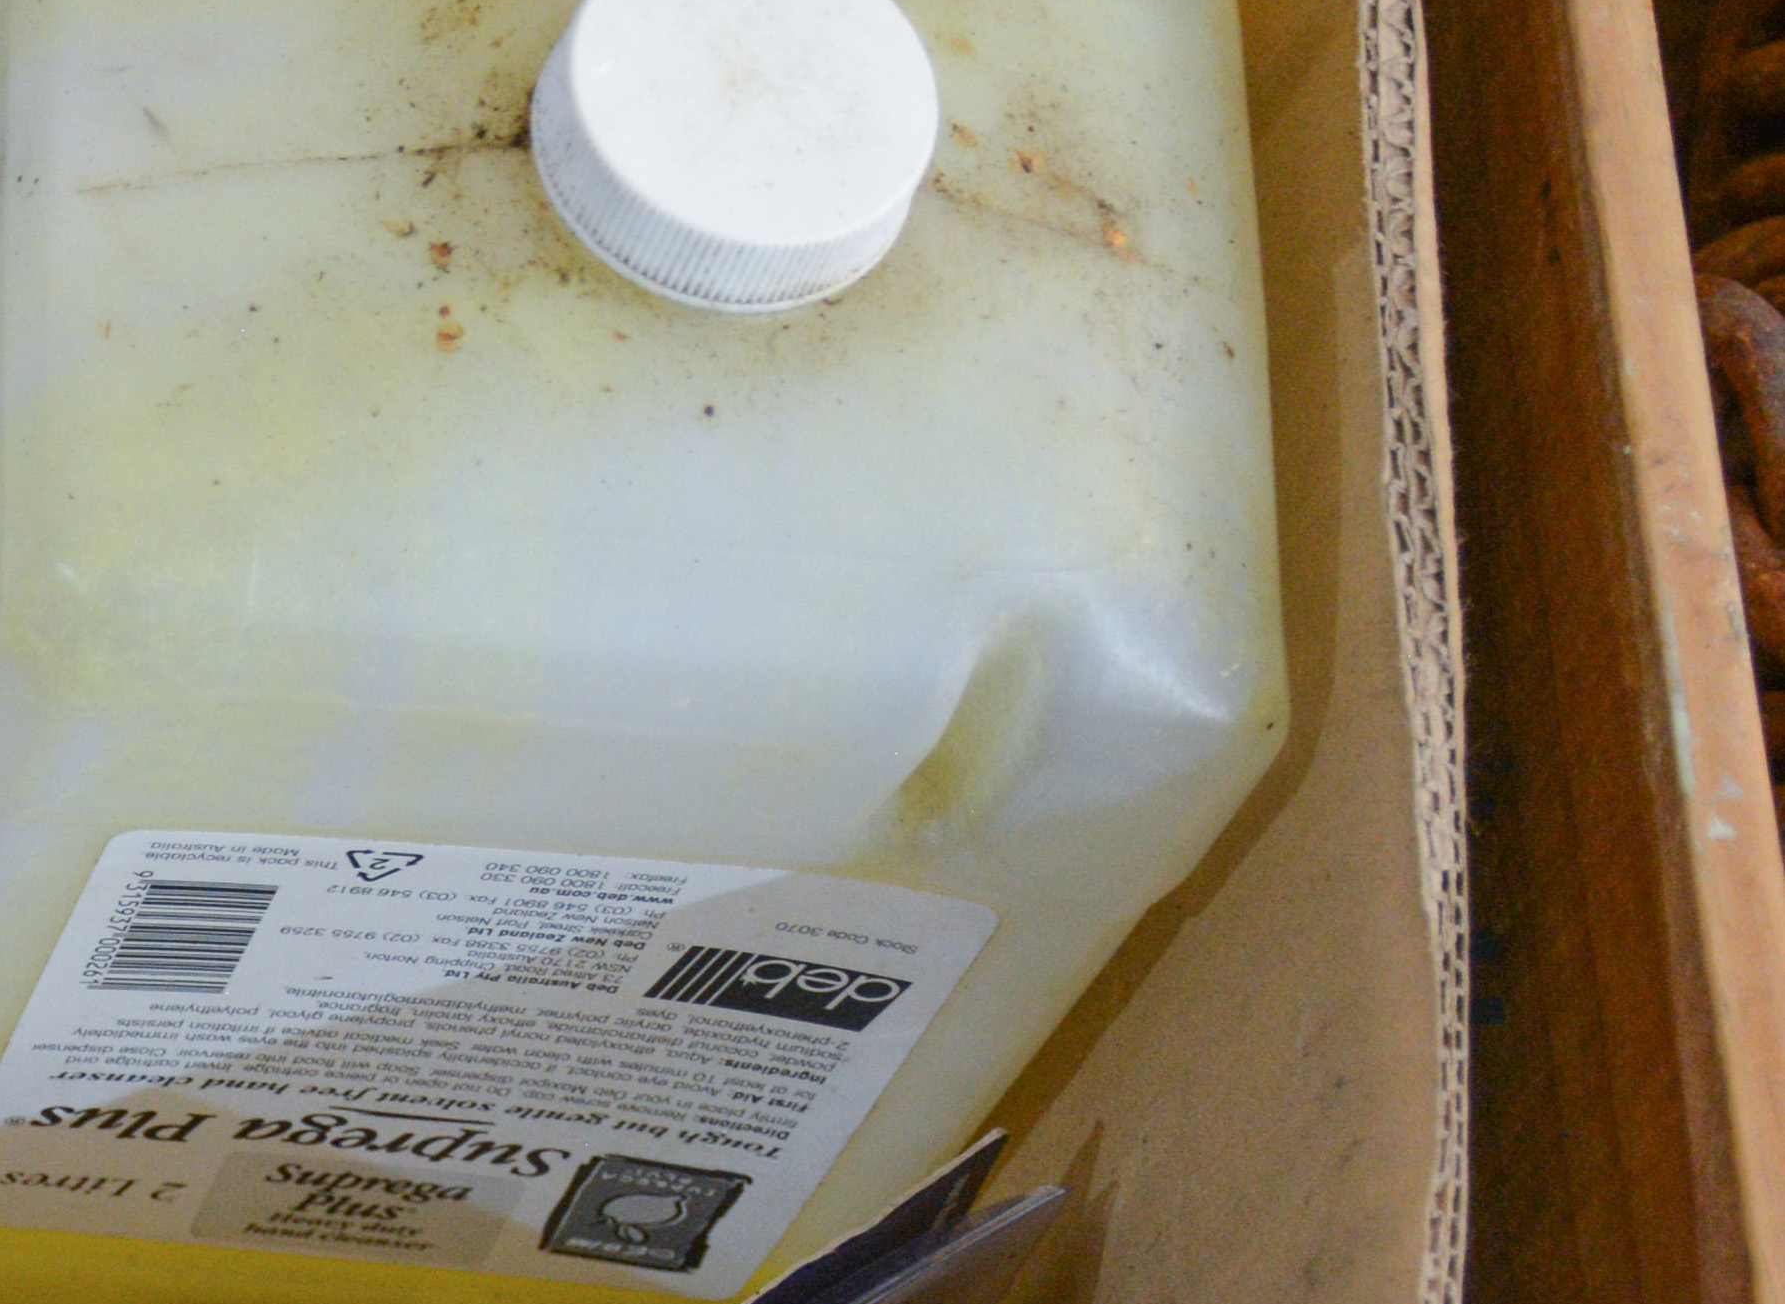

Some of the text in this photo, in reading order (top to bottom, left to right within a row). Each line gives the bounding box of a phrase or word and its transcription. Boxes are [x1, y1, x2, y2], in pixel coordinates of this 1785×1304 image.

[251, 846, 299, 856] Made
[236, 855, 251, 863] is
[258, 856, 300, 865] pack
[304, 859, 337, 870] This
[485, 862, 521, 872] 340
[524, 865, 561, 875] 090
[479, 872, 516, 882] 330
[565, 868, 609, 879] 1800
[519, 875, 556, 886] 090
[560, 878, 604, 889] 1800
[326, 884, 373, 894] 8912
[377, 888, 412, 898] 546
[418, 890, 457, 900] (03)
[529, 886, 673, 904] www.deb.com.au
[103, 880, 150, 931] 315937
[504, 897, 548, 908] 8901
[552, 901, 588, 912] 546
[594, 903, 632, 915] (03)
[491, 907, 659, 929] Nelson New Zealand
[277, 923, 327, 937] 3259
[328, 927, 378, 941] 9755
[497, 929, 566, 942] Zealand
[379, 931, 421, 944] (02)
[570, 935, 607, 946] New
[775, 921, 918, 954] Stock Code 3070
[462, 938, 512, 952] 3388
[512, 942, 565, 956] 9755
[612, 939, 646, 950] Deb
[565, 947, 607, 960] (02)
[77, 937, 121, 985] 000261
[424, 955, 495, 972] Chipping
[464, 949, 633, 973] NSW 2170 Australia
[474, 970, 501, 982] Pty
[551, 968, 598, 980] Alfred
[601, 973, 623, 983] 73
[506, 975, 581, 989] Australia
[745, 959, 899, 1009] deb
[585, 983, 619, 994] Deb
[47, 1070, 782, 1158] Tough but gentle solvent free hand cleanser
[27, 1104, 570, 1175] Suprega Plus
[265, 1162, 473, 1204] Suprega
[143, 1179, 189, 1205] 2
[294, 1193, 404, 1219] Plus
